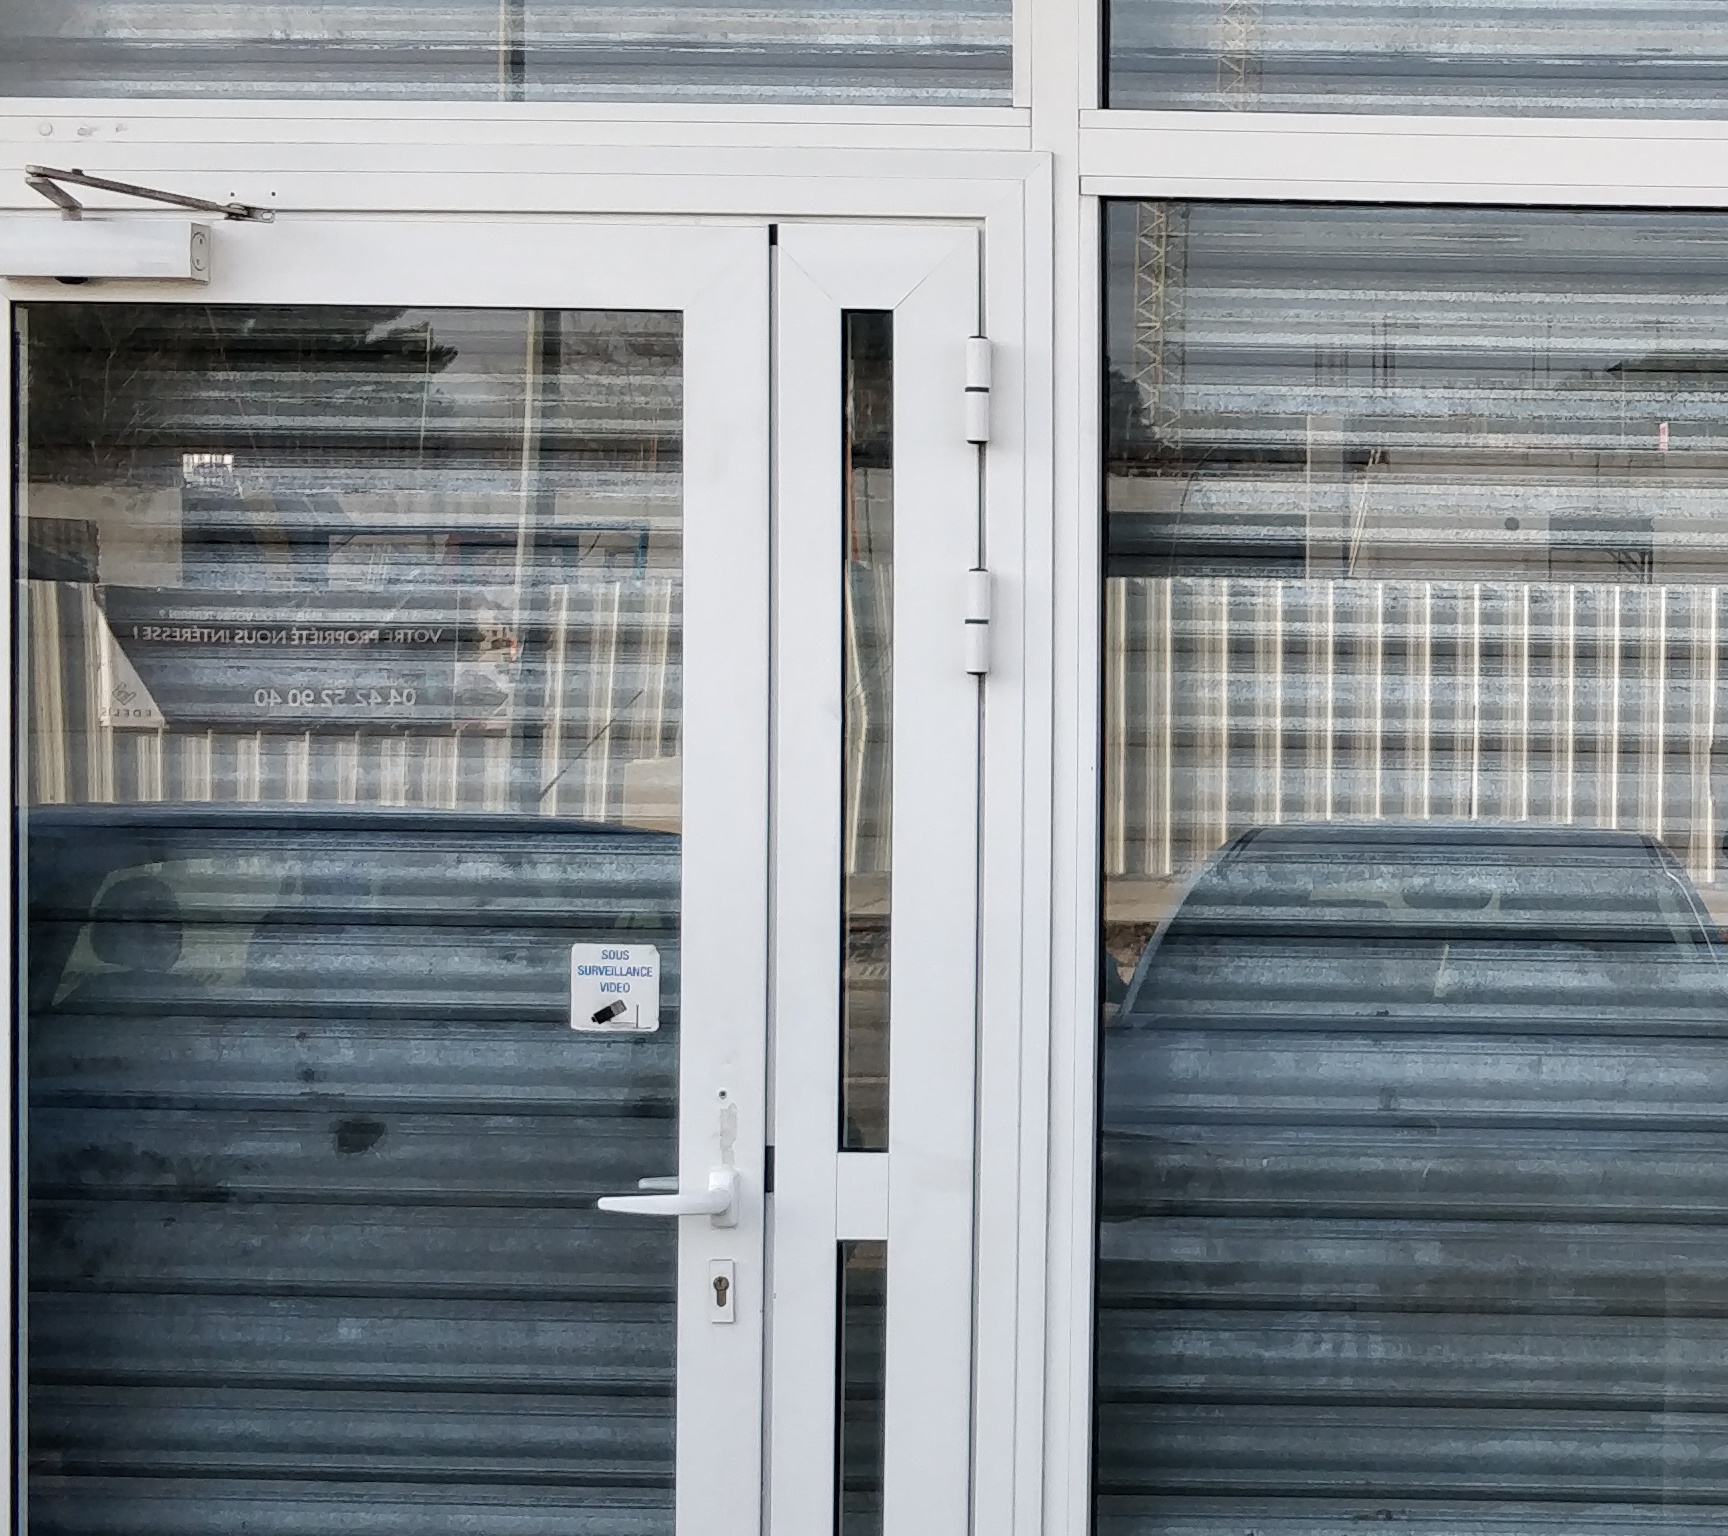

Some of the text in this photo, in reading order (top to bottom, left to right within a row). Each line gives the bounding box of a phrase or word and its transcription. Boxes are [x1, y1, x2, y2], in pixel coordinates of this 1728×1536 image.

[601, 949, 630, 961] SOUS
[577, 965, 653, 978] SURVEILLANCE
[600, 981, 631, 994] VIDEO
